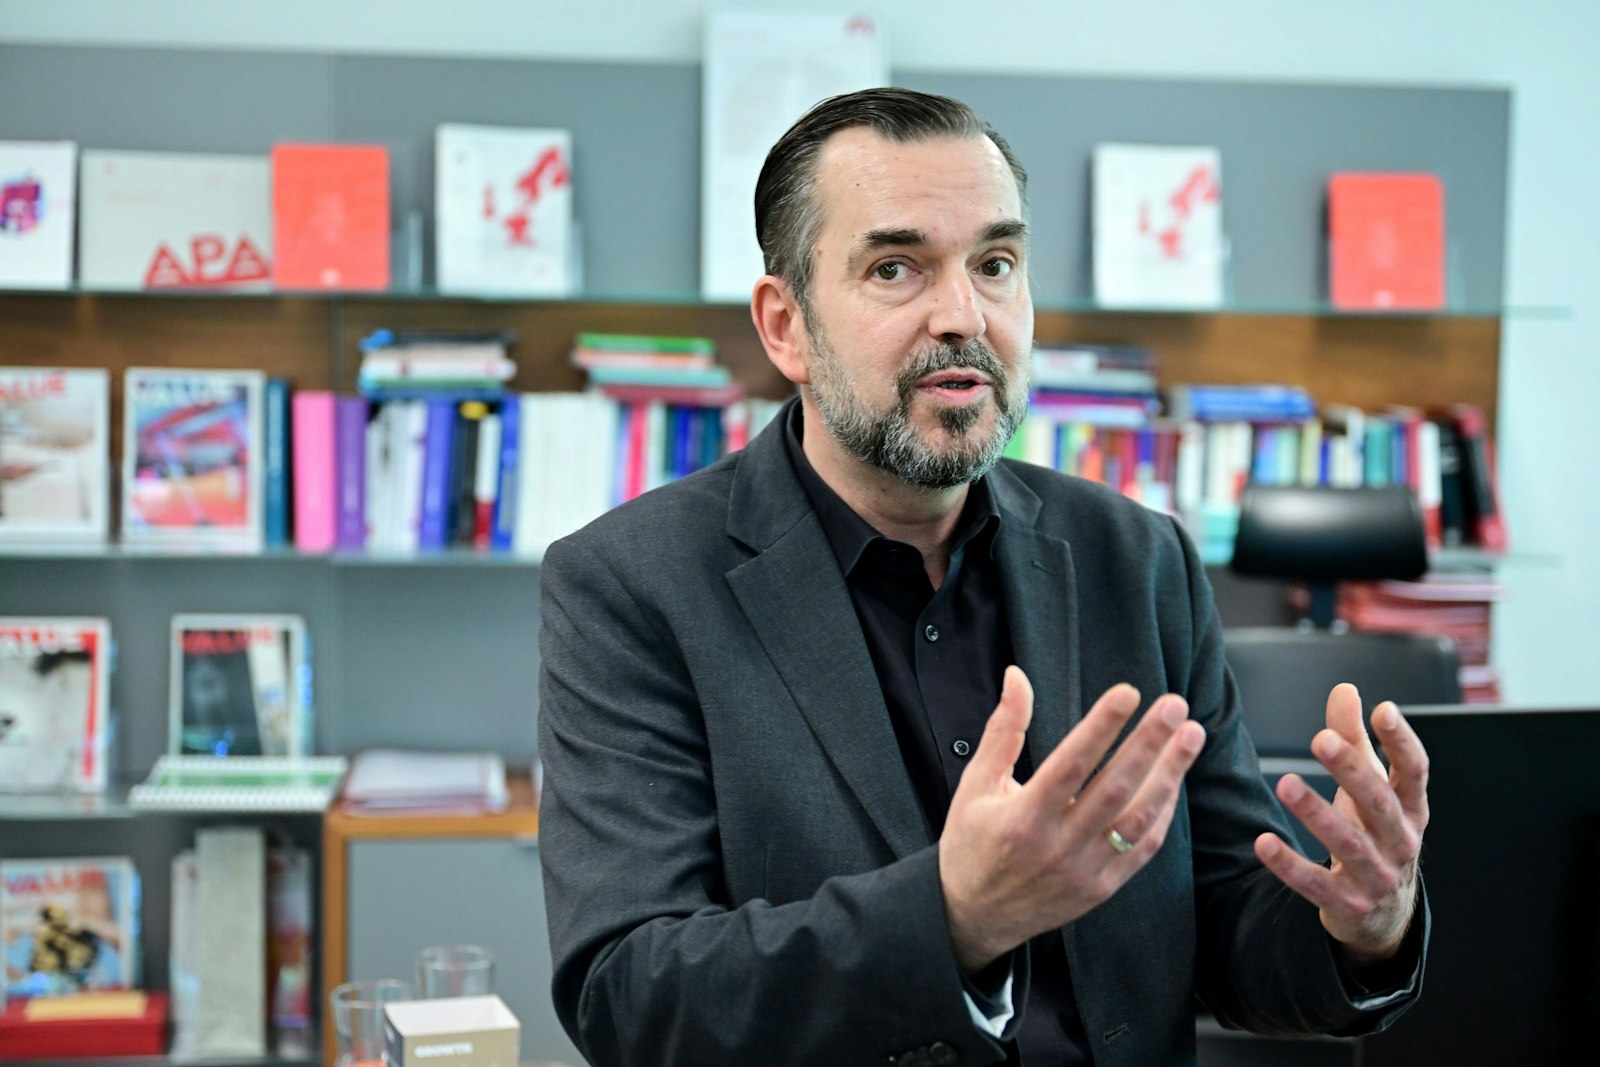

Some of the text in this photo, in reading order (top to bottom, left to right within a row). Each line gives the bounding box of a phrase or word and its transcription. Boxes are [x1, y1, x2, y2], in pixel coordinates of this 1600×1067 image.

[143, 234, 271, 287] APA
[0, 370, 66, 402] ALUE
[0, 627, 82, 657] ALUE
